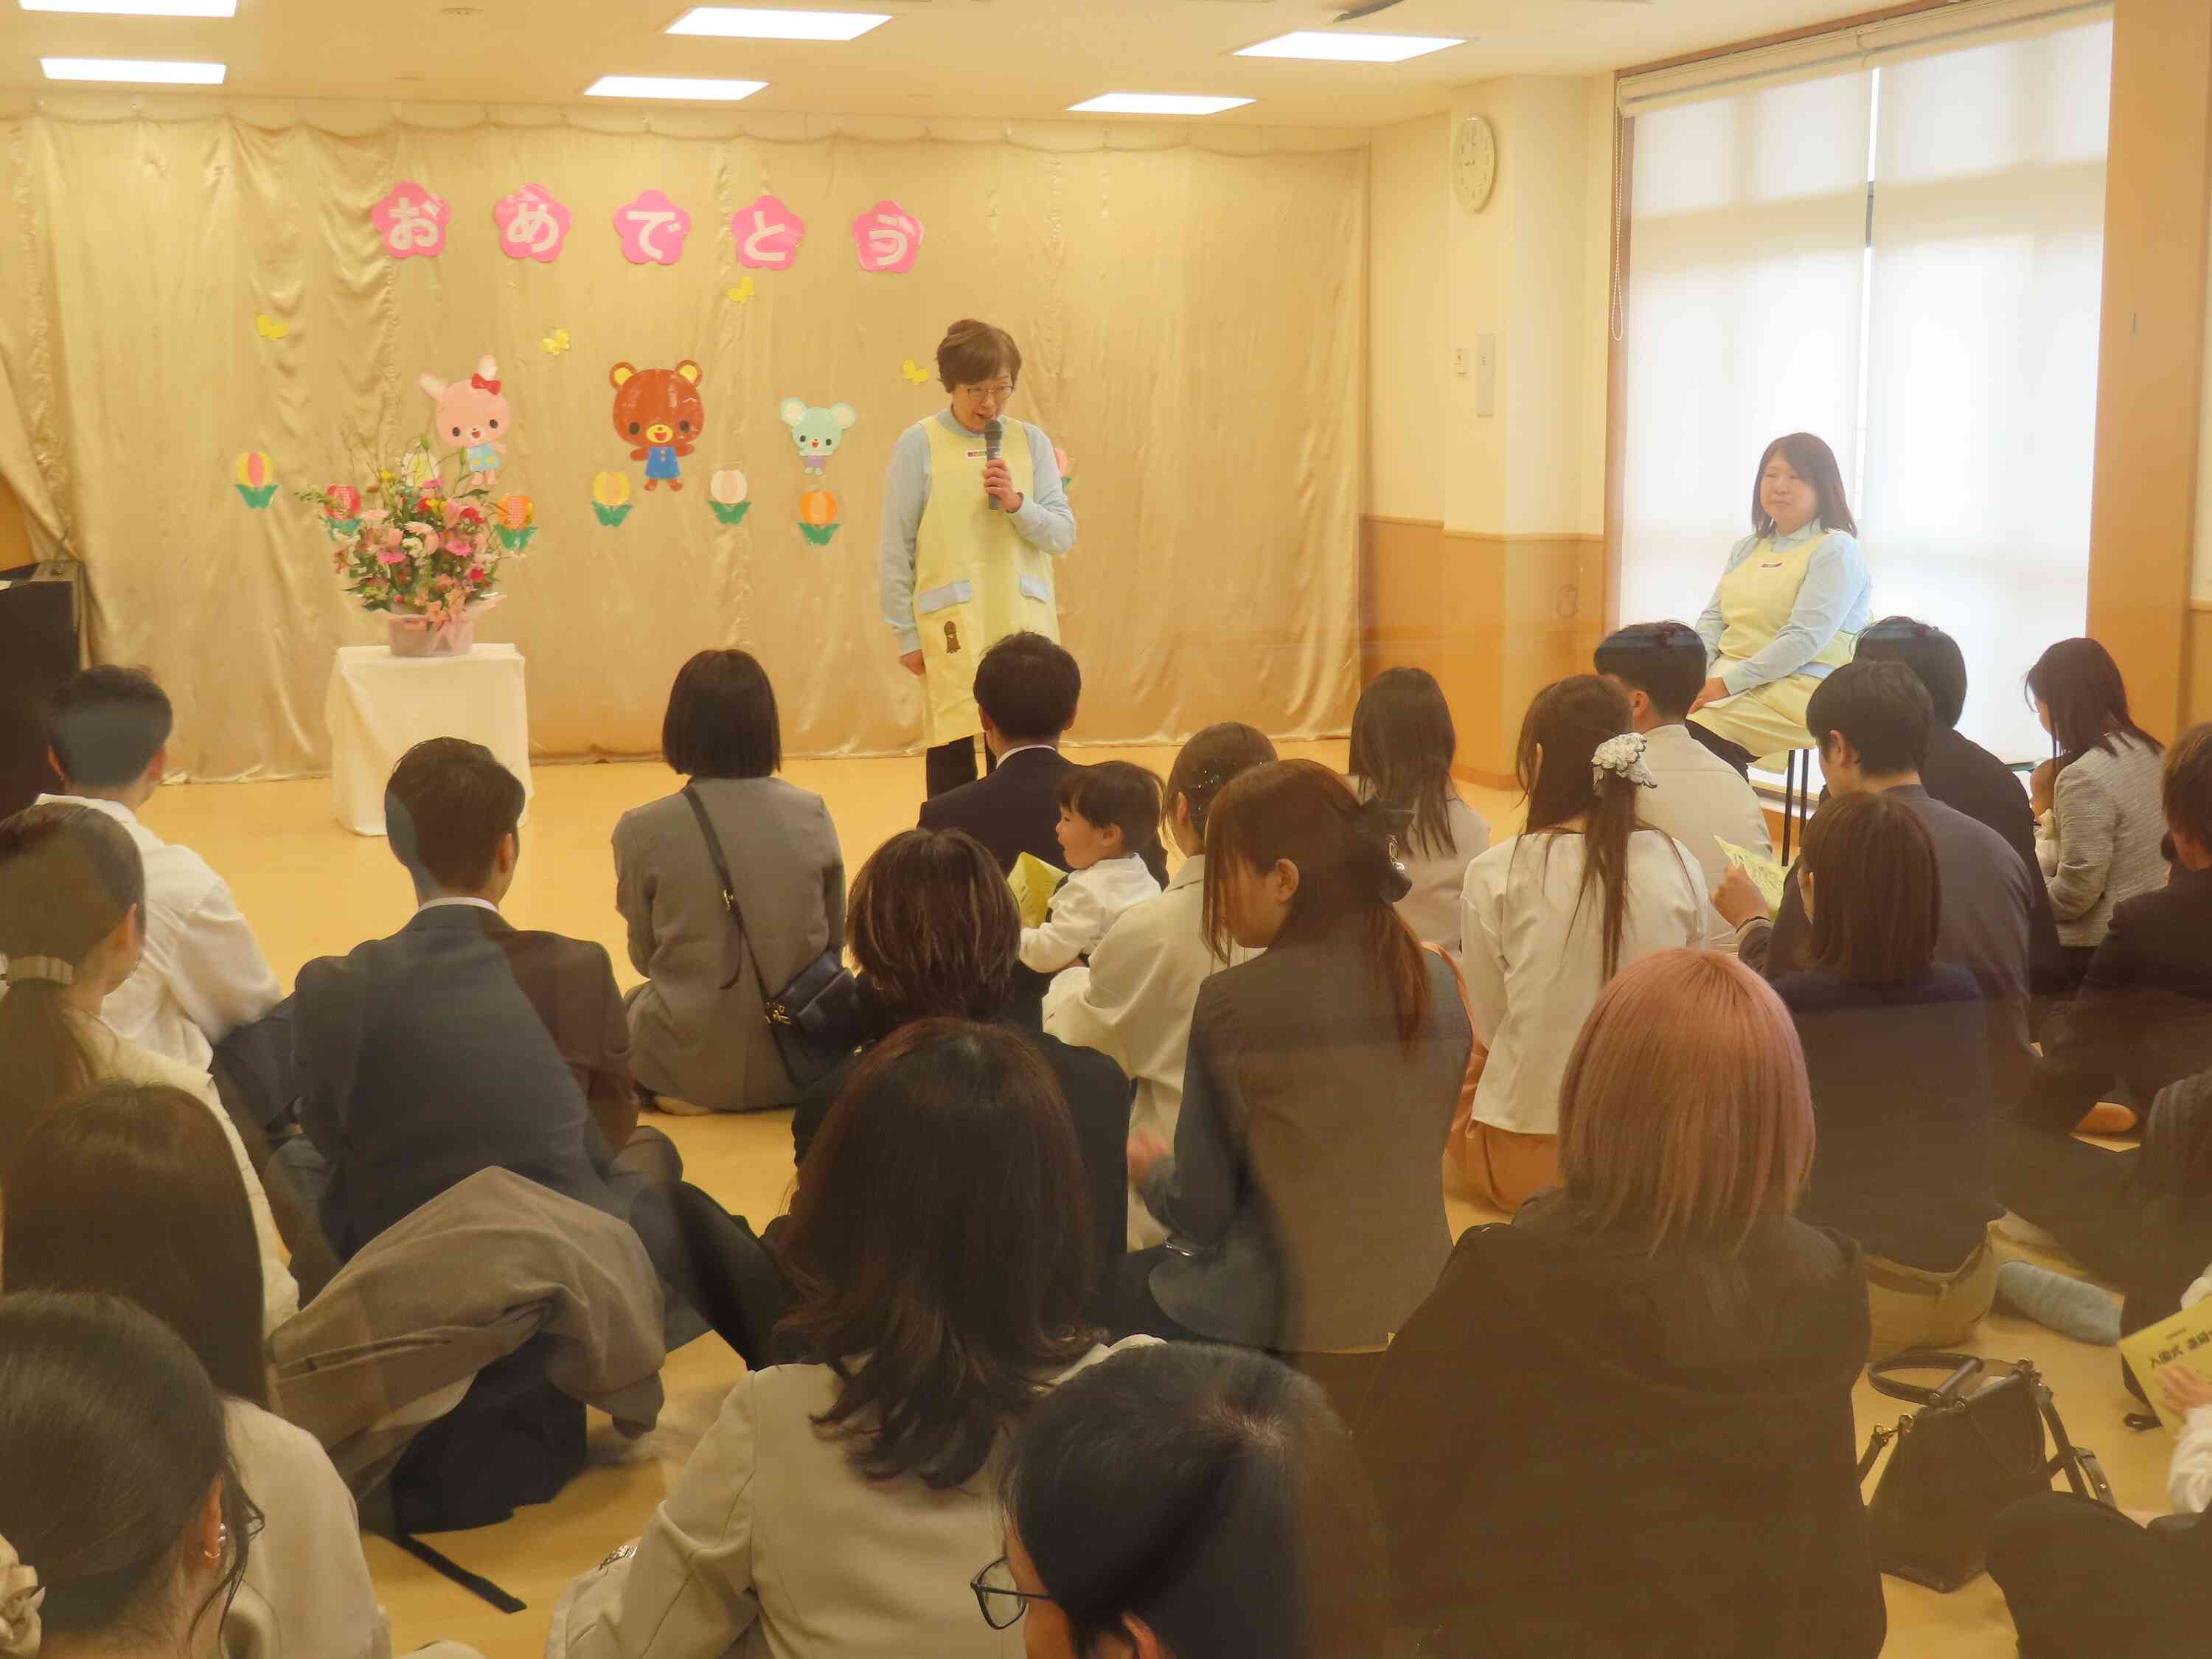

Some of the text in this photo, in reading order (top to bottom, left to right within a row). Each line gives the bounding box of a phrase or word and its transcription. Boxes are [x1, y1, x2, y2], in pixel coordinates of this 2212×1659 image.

[389, 196, 908, 266] おめでとう
